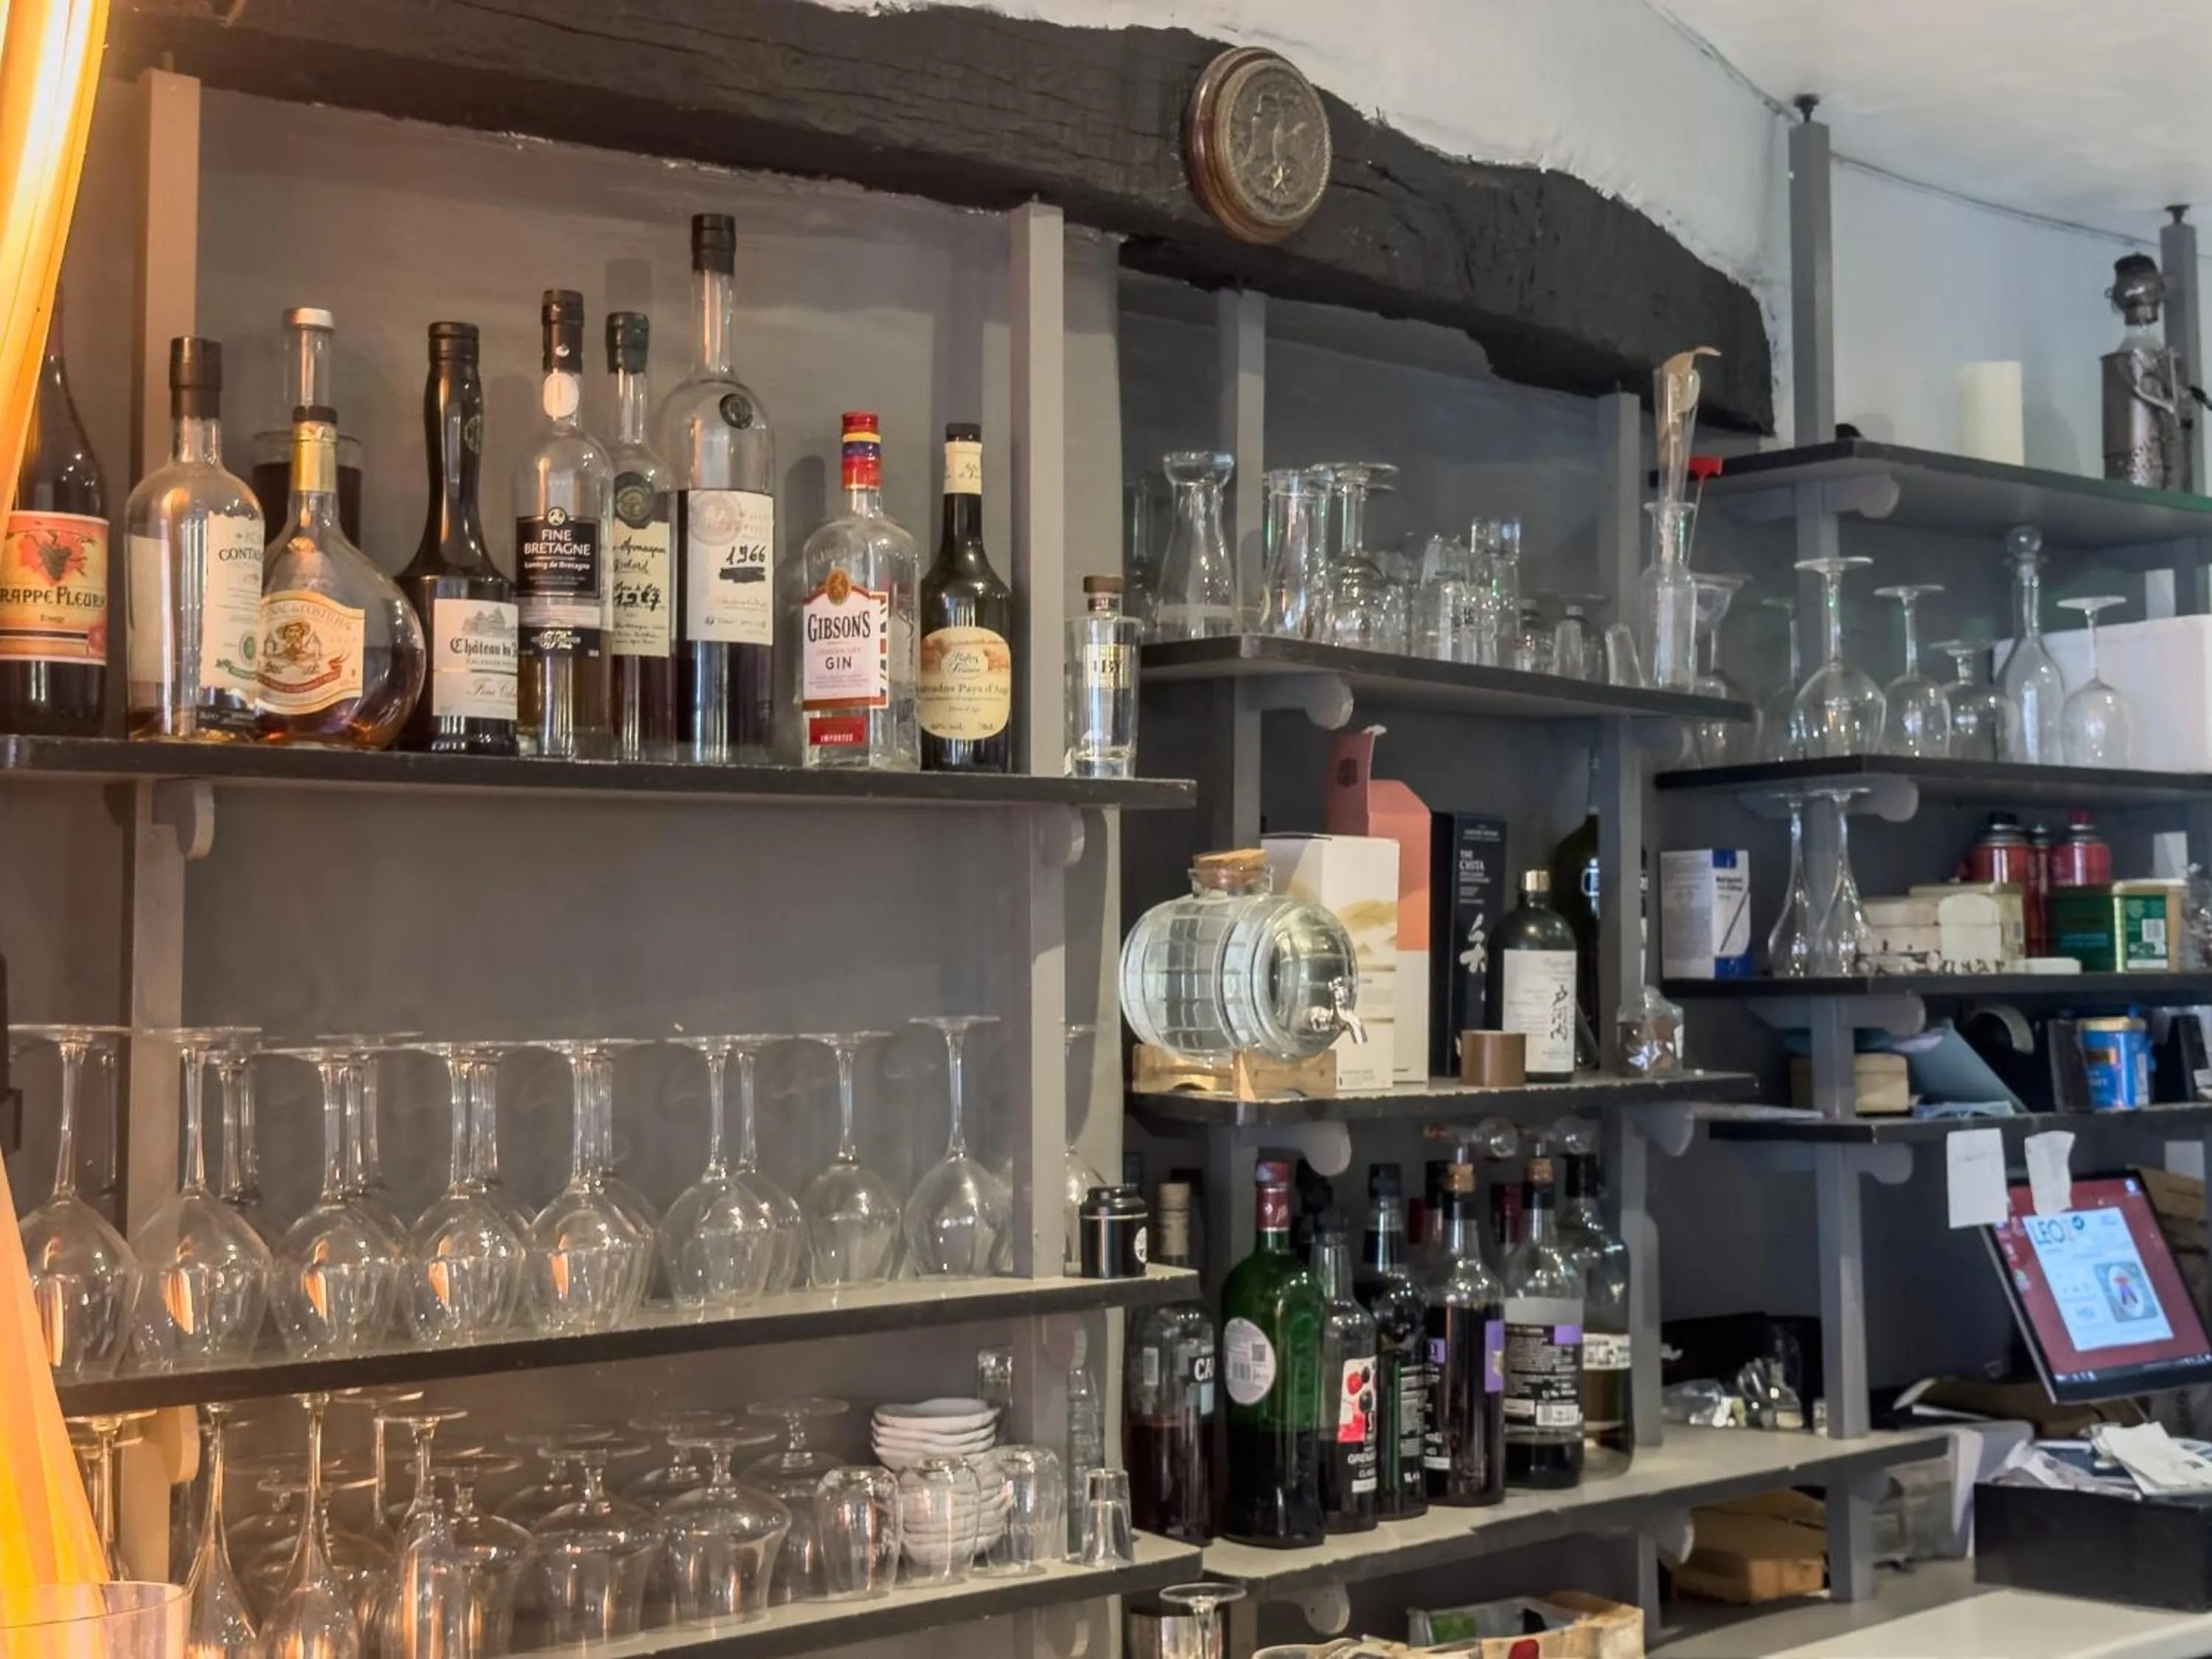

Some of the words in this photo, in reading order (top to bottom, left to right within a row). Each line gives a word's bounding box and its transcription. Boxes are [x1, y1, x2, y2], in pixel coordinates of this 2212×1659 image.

[542, 529, 572, 541] FINE
[524, 542, 591, 557] BRETAGNE
[726, 544, 766, 564] 1966
[808, 611, 870, 642] GIBSON'S
[825, 655, 852, 670] GIN
[1194, 1357, 1215, 1382] CA
